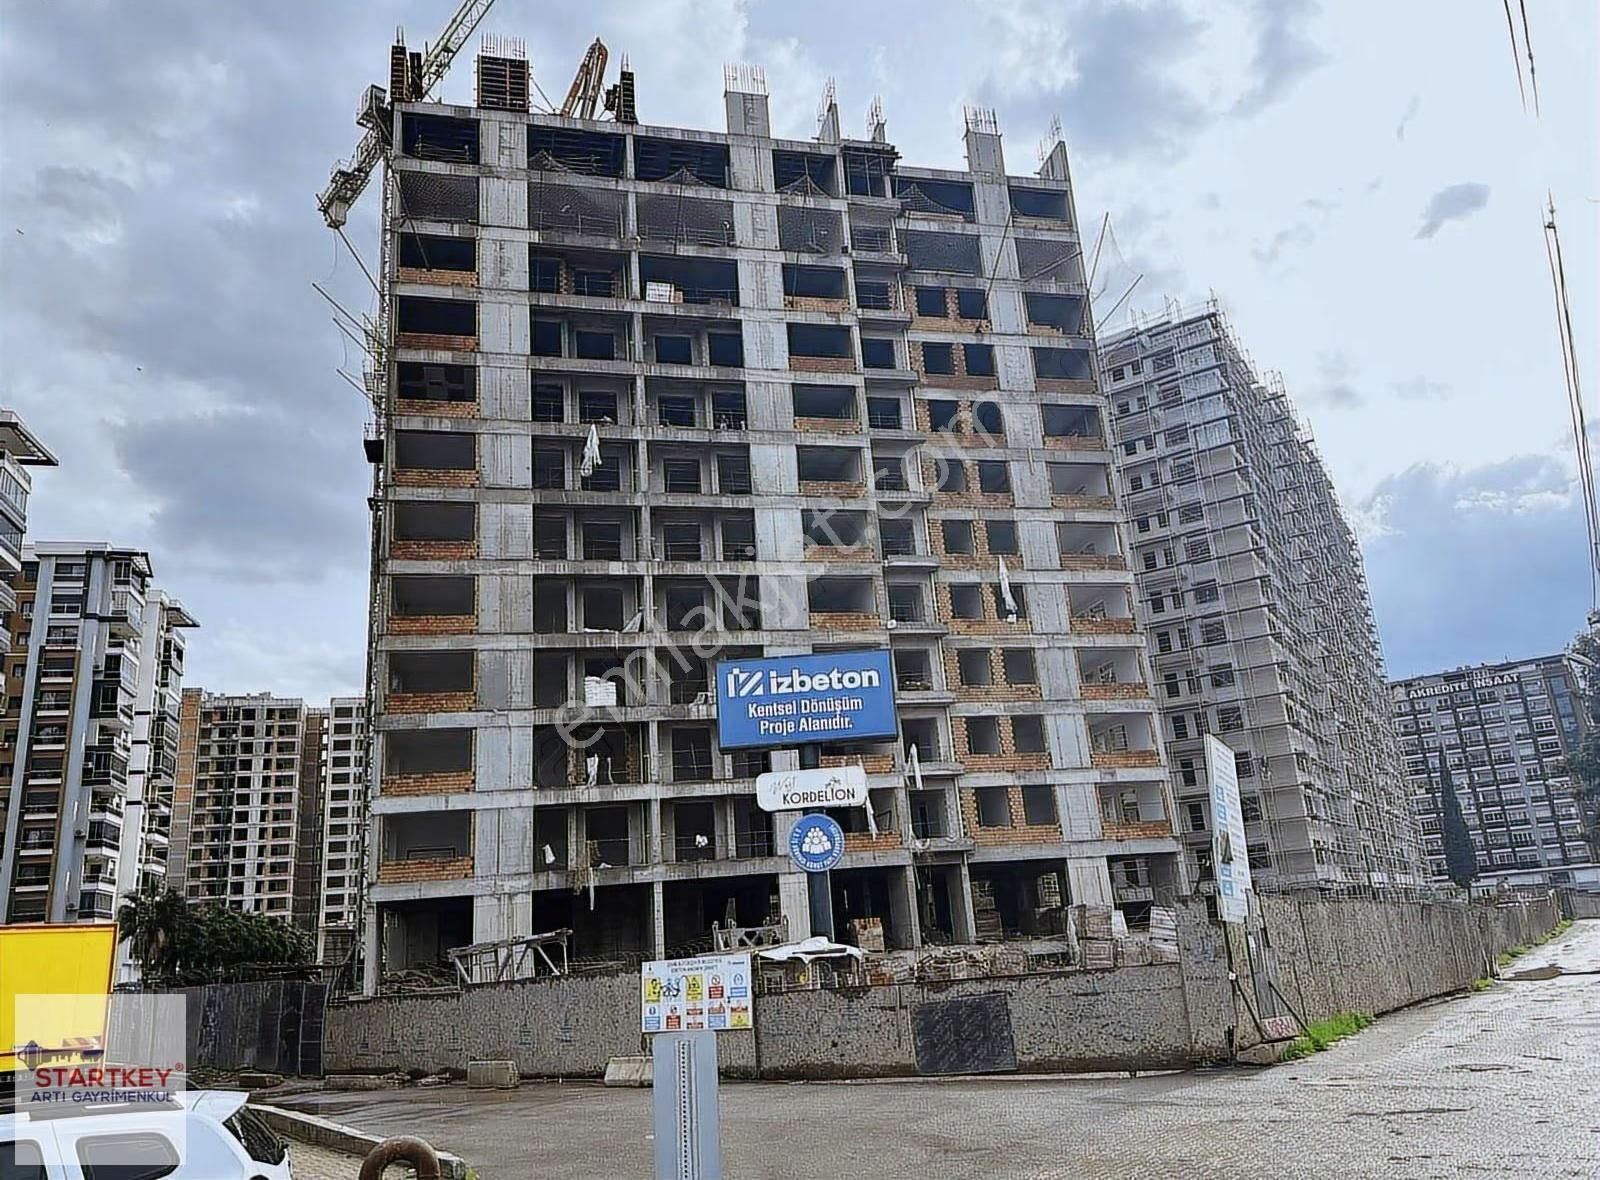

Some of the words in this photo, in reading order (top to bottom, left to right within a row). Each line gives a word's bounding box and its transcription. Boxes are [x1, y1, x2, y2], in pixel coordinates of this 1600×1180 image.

[769, 667, 880, 694] izbeton
[748, 700, 797, 718] Kentsel
[801, 697, 863, 714] Dönüşüm
[760, 718, 795, 736] Proje
[799, 714, 853, 732] Alanıdır.
[782, 787, 856, 805] KORDELION
